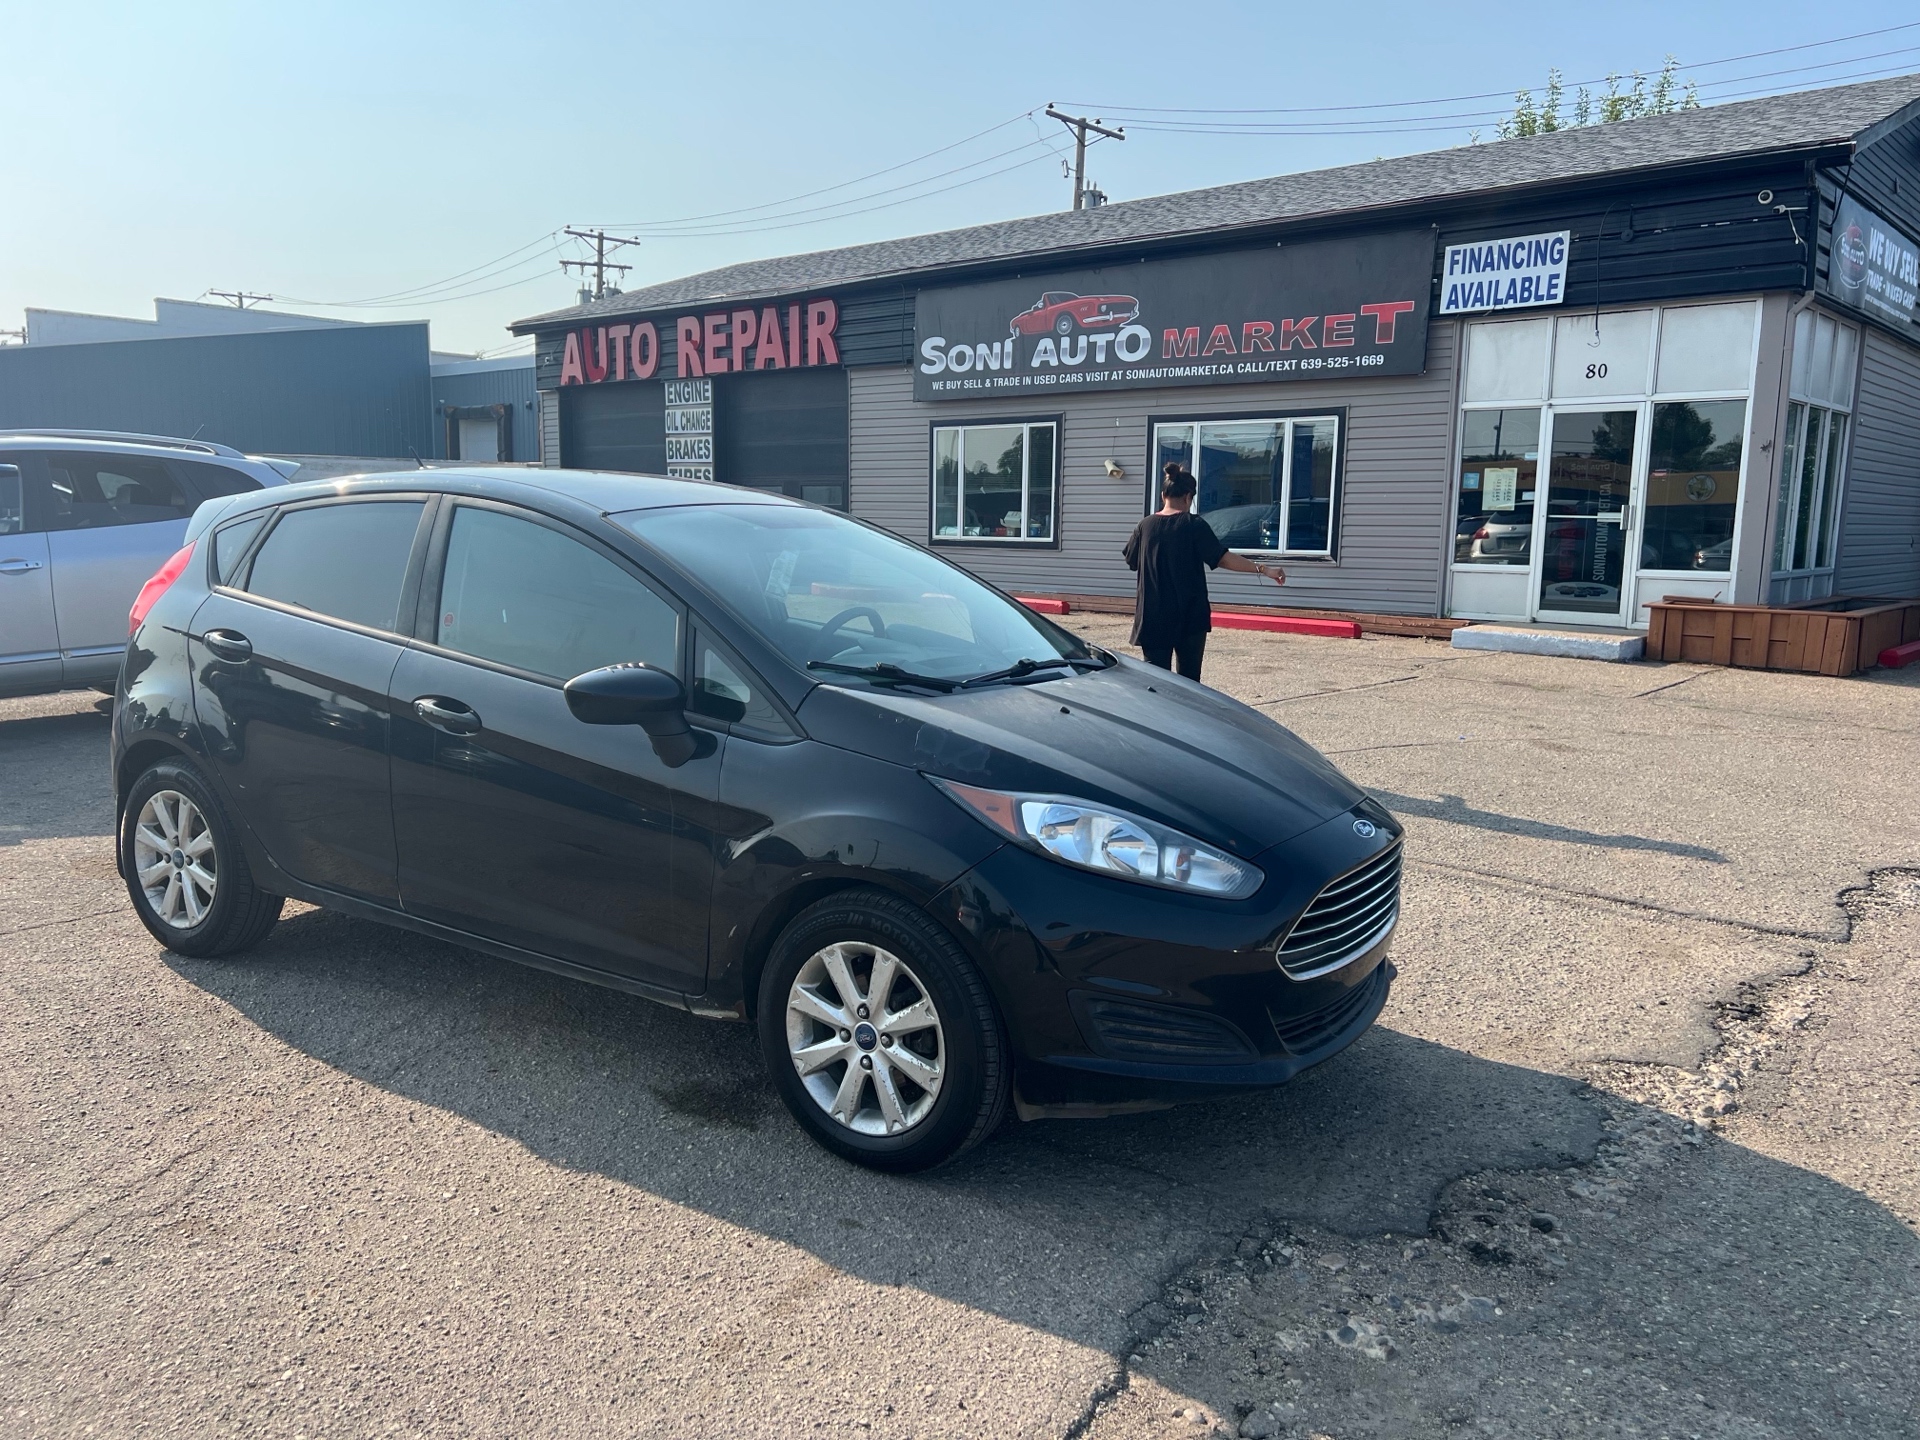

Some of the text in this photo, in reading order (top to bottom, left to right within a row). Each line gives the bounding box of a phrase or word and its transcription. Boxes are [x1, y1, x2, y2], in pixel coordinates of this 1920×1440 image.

[1449, 236, 1565, 276] FINANCING
[1445, 273, 1561, 310] AVAILABLE
[560, 297, 841, 386] AUTO REPAIR
[920, 300, 1415, 375] SONI AUTO MARKET
[932, 354, 1385, 391] WE BUY SELL & TRADE IN USED CARS VISIT AT SONIAUTOMARKET.CA CALL/TEXT 639-525-1669
[1585, 363, 1608, 380] 80
[667, 381, 710, 404] ENGINE
[666, 409, 711, 432] OIL CHANGE
[667, 438, 711, 460] BRAKES
[1592, 482, 1613, 582] SONIAUTOMAKET.CA
